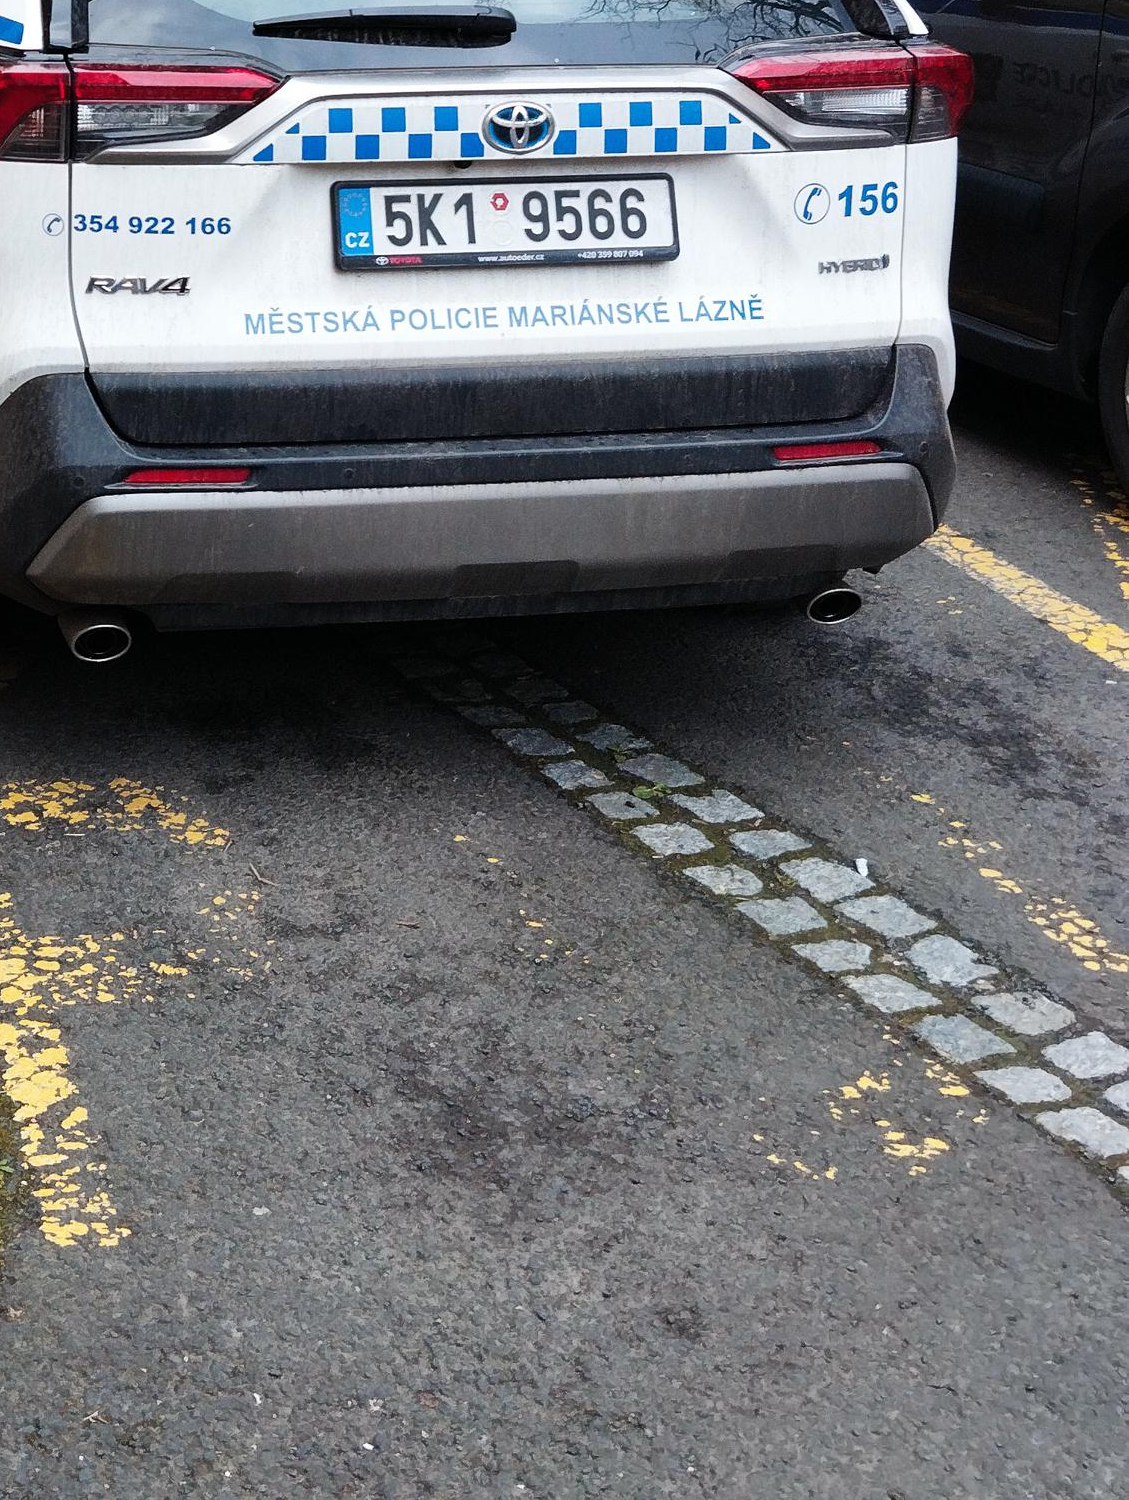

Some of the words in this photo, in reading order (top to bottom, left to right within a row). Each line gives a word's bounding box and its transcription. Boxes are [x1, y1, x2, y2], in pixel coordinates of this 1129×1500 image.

[838, 181, 899, 217] 156
[73, 214, 119, 233] 354
[128, 216, 175, 234] 922
[185, 217, 232, 235] 166
[383, 192, 477, 247] 5K1
[522, 187, 647, 243] 9566
[344, 231, 370, 249] CZ
[818, 257, 881, 274] HYBRID
[85, 275, 191, 296] RAV4
[244, 305, 381, 335] MĚSTSKÁ
[389, 306, 499, 331] POLICIE
[508, 296, 670, 328] MARIÁNSKÉ
[678, 293, 765, 322] LÁZNĚ
